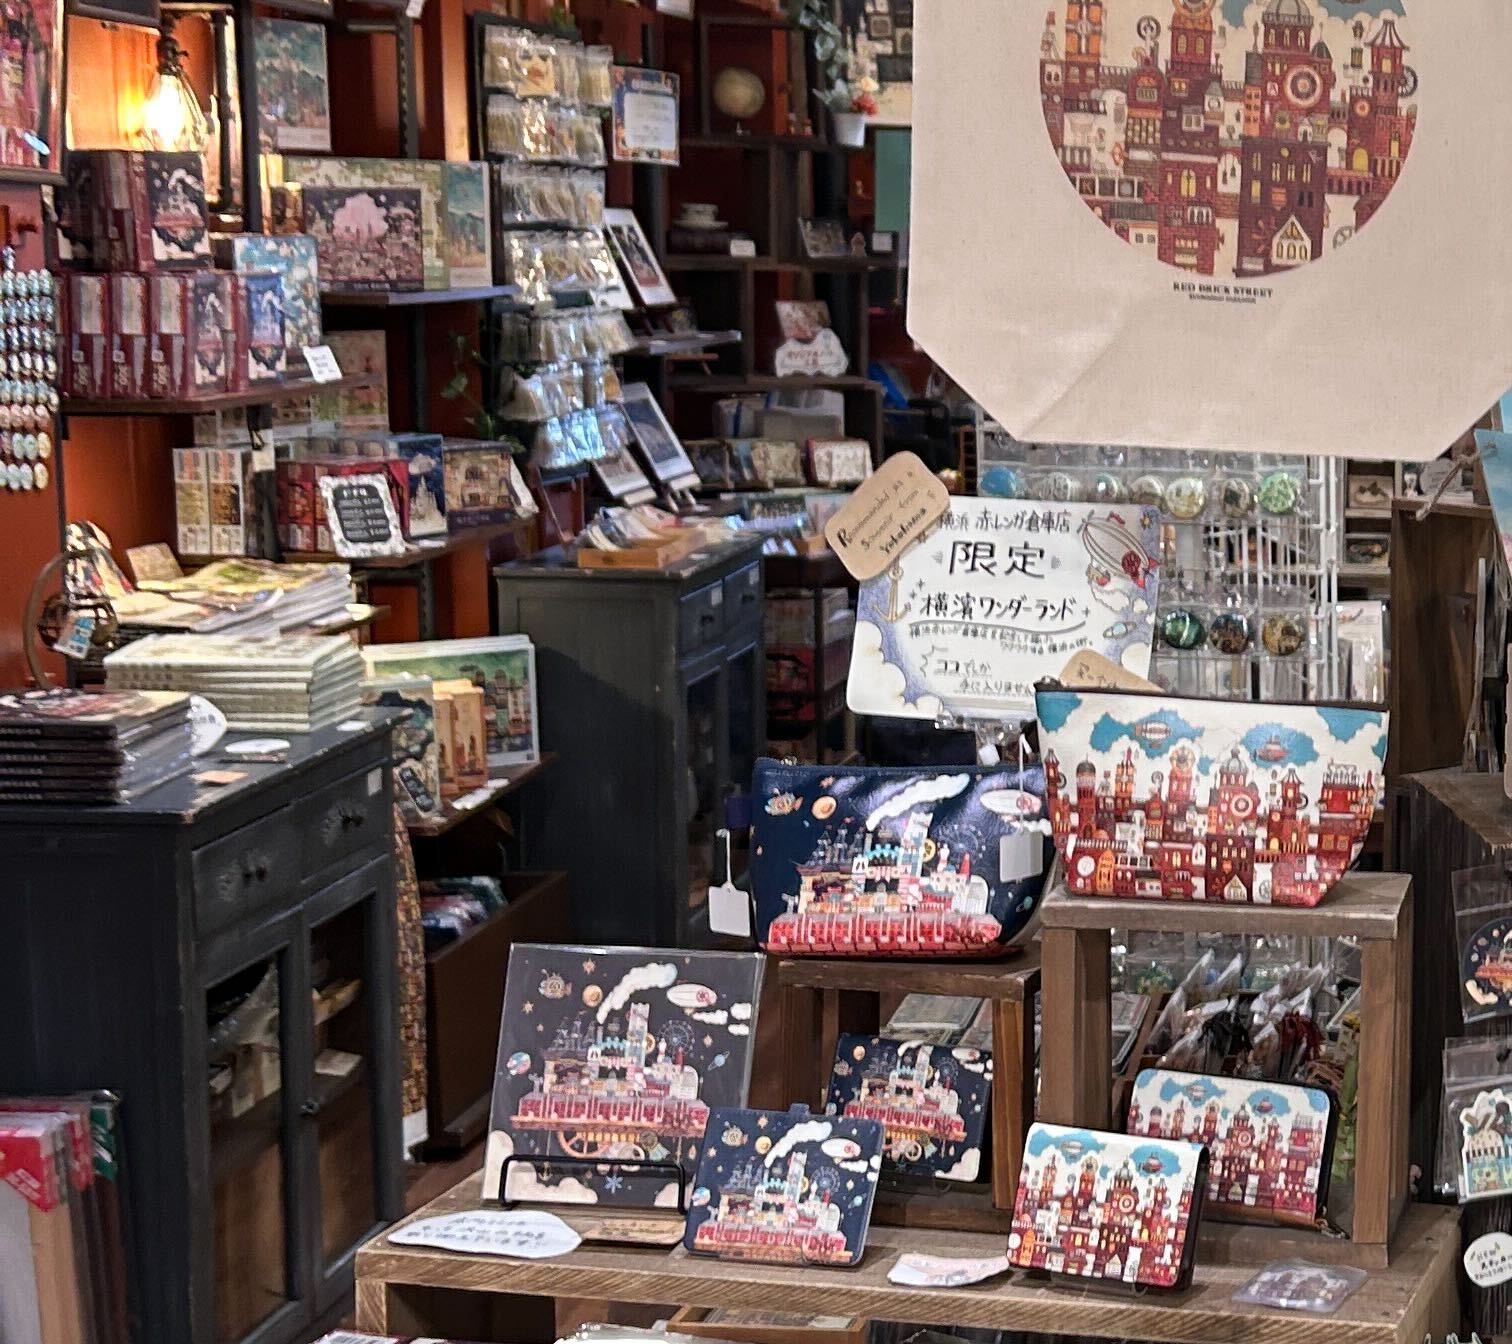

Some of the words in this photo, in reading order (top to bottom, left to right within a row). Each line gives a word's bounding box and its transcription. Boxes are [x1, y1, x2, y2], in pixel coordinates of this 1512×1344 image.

[975, 508, 1073, 535] 赤レンガ倉庫店
[949, 540, 1047, 579] 限定
[919, 591, 1078, 622] 横濱ワンダーランド
